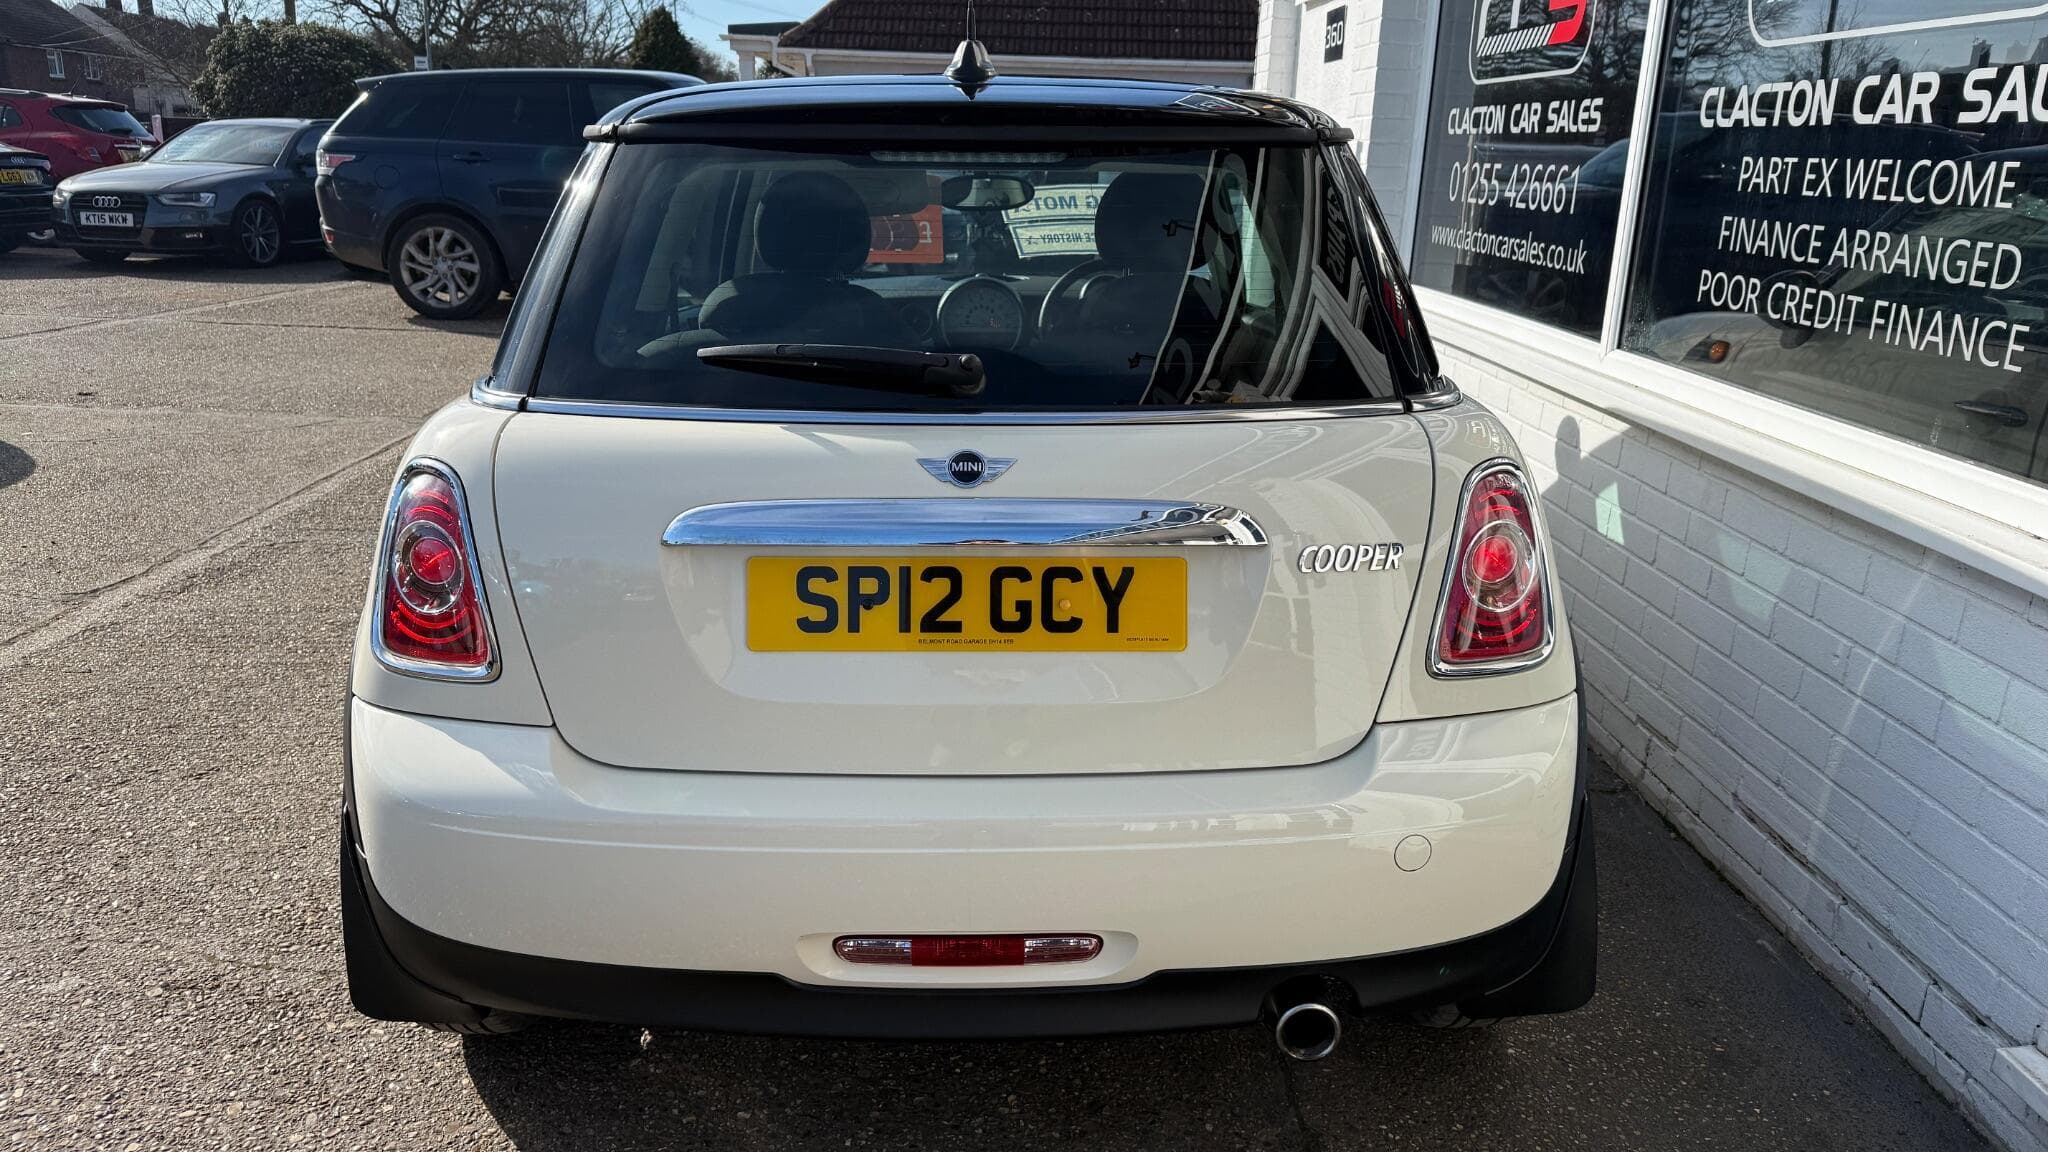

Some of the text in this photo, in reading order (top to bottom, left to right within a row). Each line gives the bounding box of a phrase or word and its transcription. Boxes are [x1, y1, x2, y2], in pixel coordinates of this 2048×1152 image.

[1325, 20, 1344, 49] 360
[1448, 97, 1604, 135] CLACTON CAR SALES
[1700, 78, 1839, 128] CLACTON
[1852, 71, 1940, 124] CAR
[1449, 161, 1581, 215] 01255 426661
[1738, 156, 2021, 209] PART EX WELCOME
[85, 212, 106, 224] KT15
[1431, 221, 1588, 275] www.clactoncarsales.co.uk
[1718, 215, 2022, 290] FINANCE ARRANGED
[1697, 269, 1761, 314] POOR
[1767, 282, 1864, 335] CREDIT
[1868, 300, 2030, 373] FINANCE
[951, 461, 983, 472] MINI
[1298, 542, 1404, 573] COOPER
[796, 565, 1135, 634] SP12 GCY
